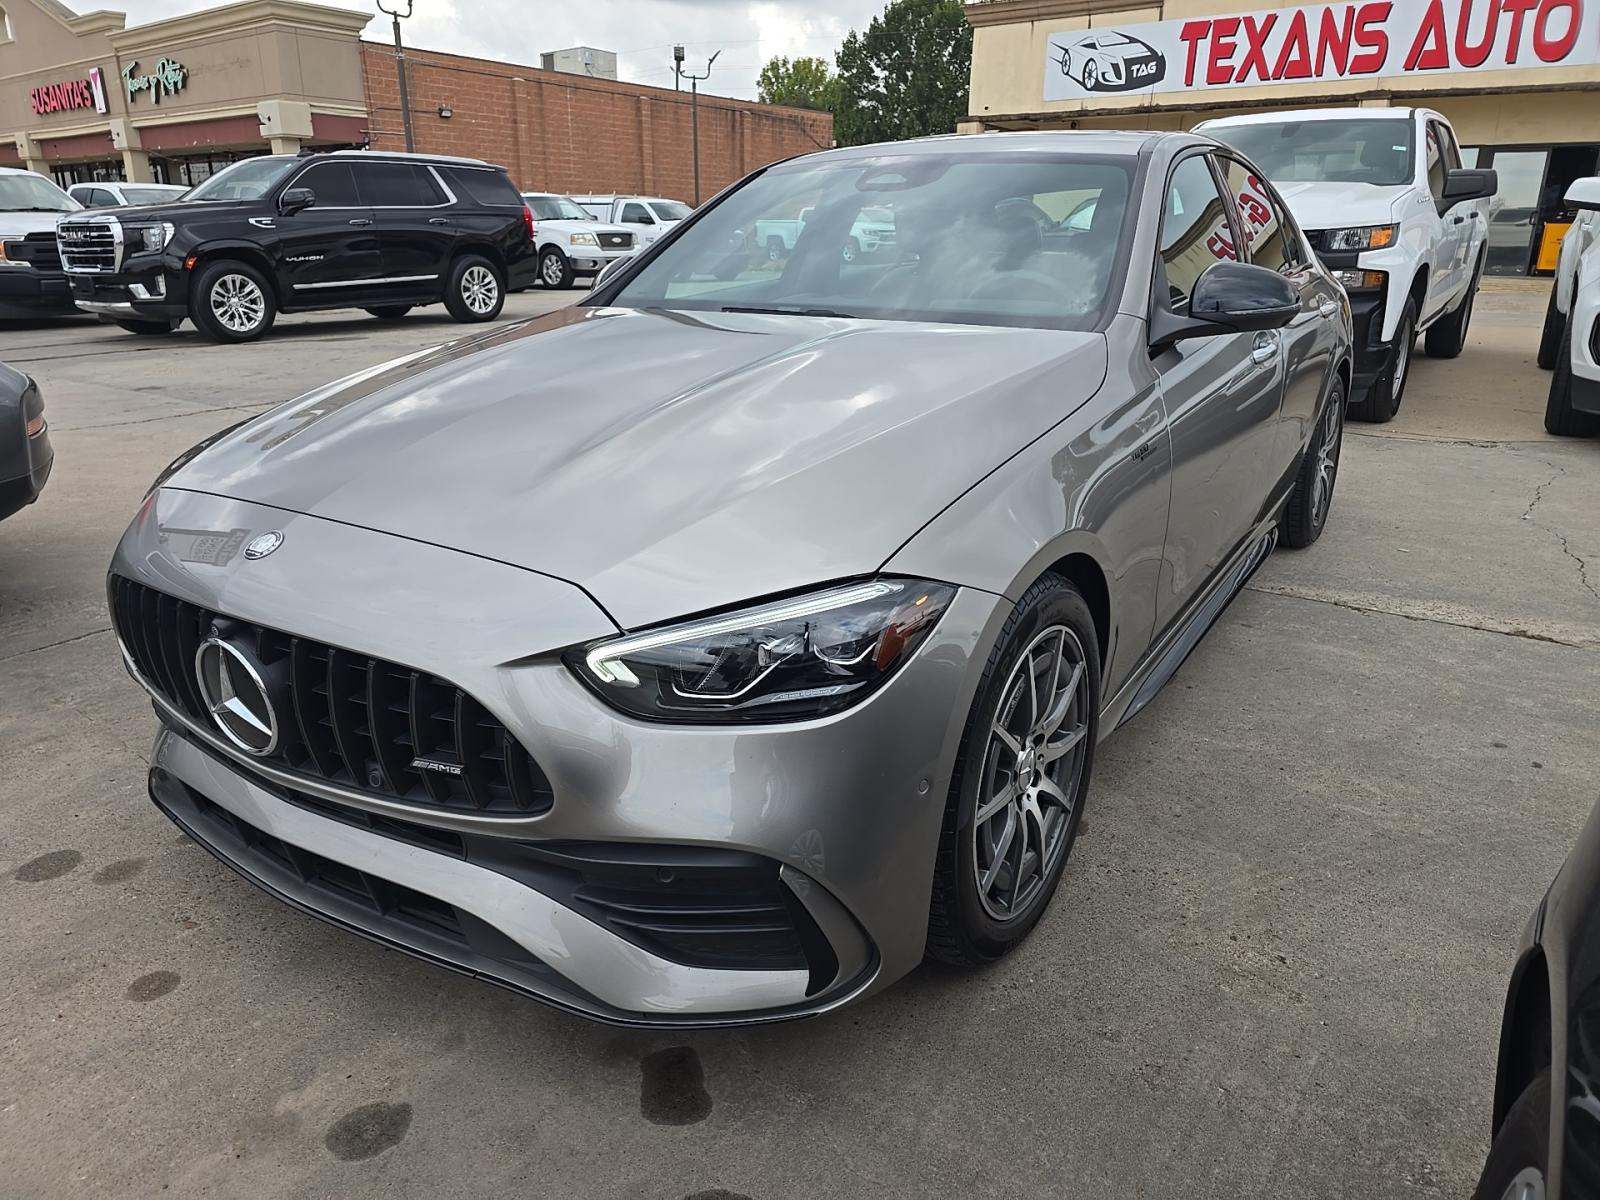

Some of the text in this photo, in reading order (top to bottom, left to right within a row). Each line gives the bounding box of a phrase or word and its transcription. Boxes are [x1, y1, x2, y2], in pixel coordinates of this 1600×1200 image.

[1179, 0, 1584, 87] TEXANS AUTO
[1130, 61, 1157, 78] TAG
[30, 79, 93, 115] SUSANITA'S
